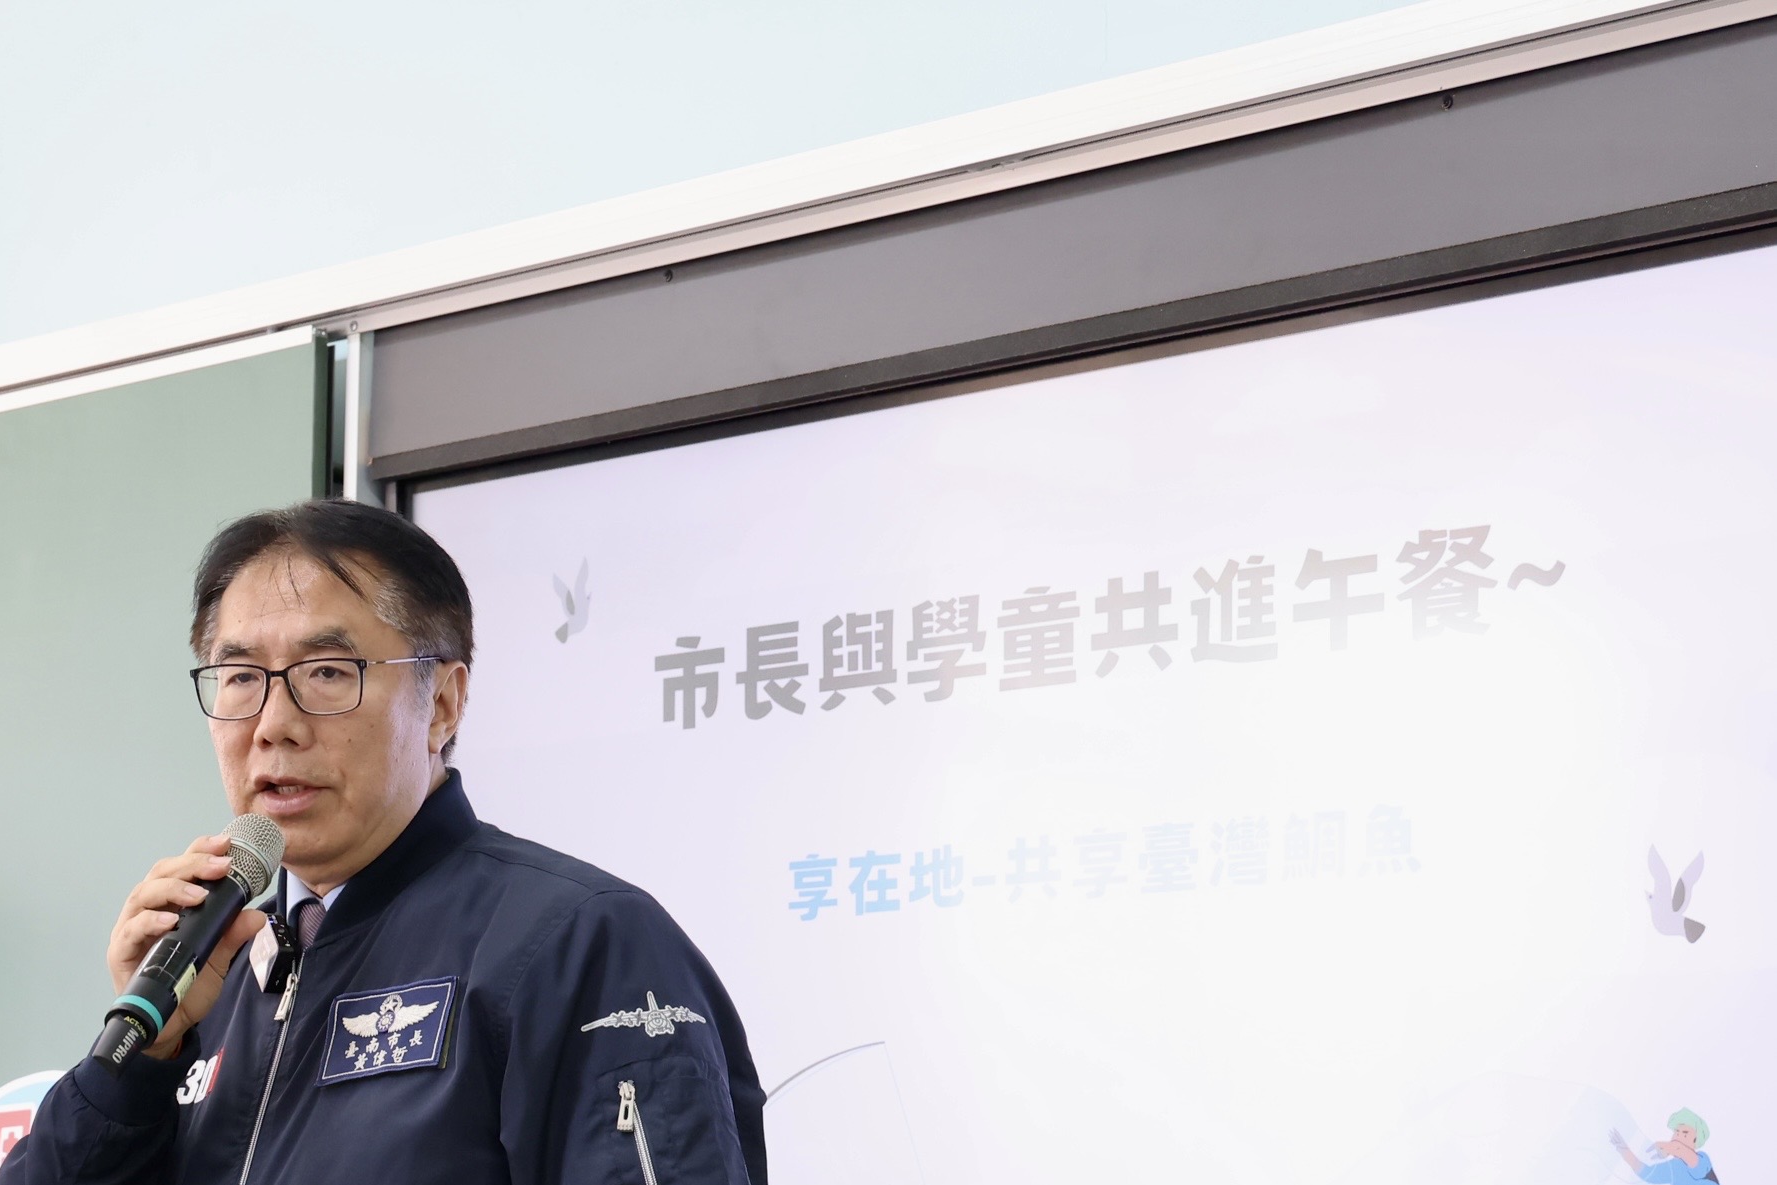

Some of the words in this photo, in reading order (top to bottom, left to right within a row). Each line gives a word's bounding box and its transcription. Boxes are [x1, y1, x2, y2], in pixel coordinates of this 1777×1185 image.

[653, 523, 1567, 730] 市長與學童共進午餐~
[112, 1027, 139, 1064] MIPRO
